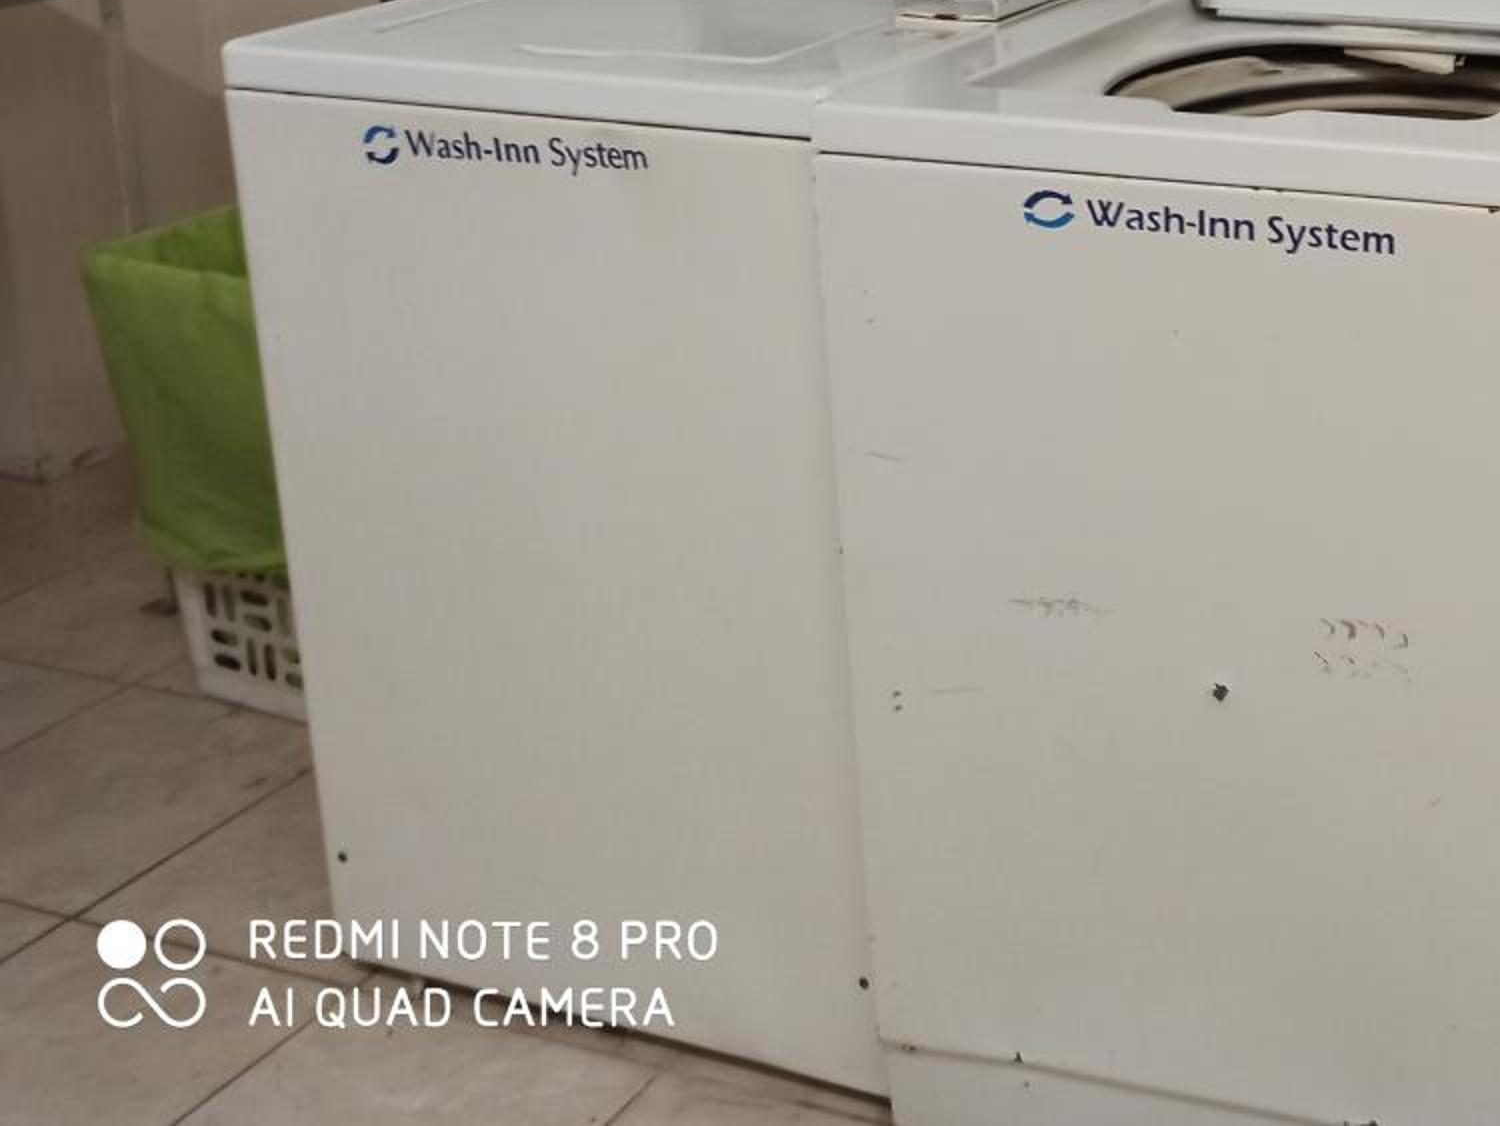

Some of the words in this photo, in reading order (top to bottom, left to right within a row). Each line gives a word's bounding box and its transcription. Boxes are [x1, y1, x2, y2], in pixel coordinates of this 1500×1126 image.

[404, 129, 541, 164] Wash-Inn
[548, 137, 650, 176] System
[1086, 199, 1255, 241] Wash-Inn
[1267, 216, 1396, 254] System
